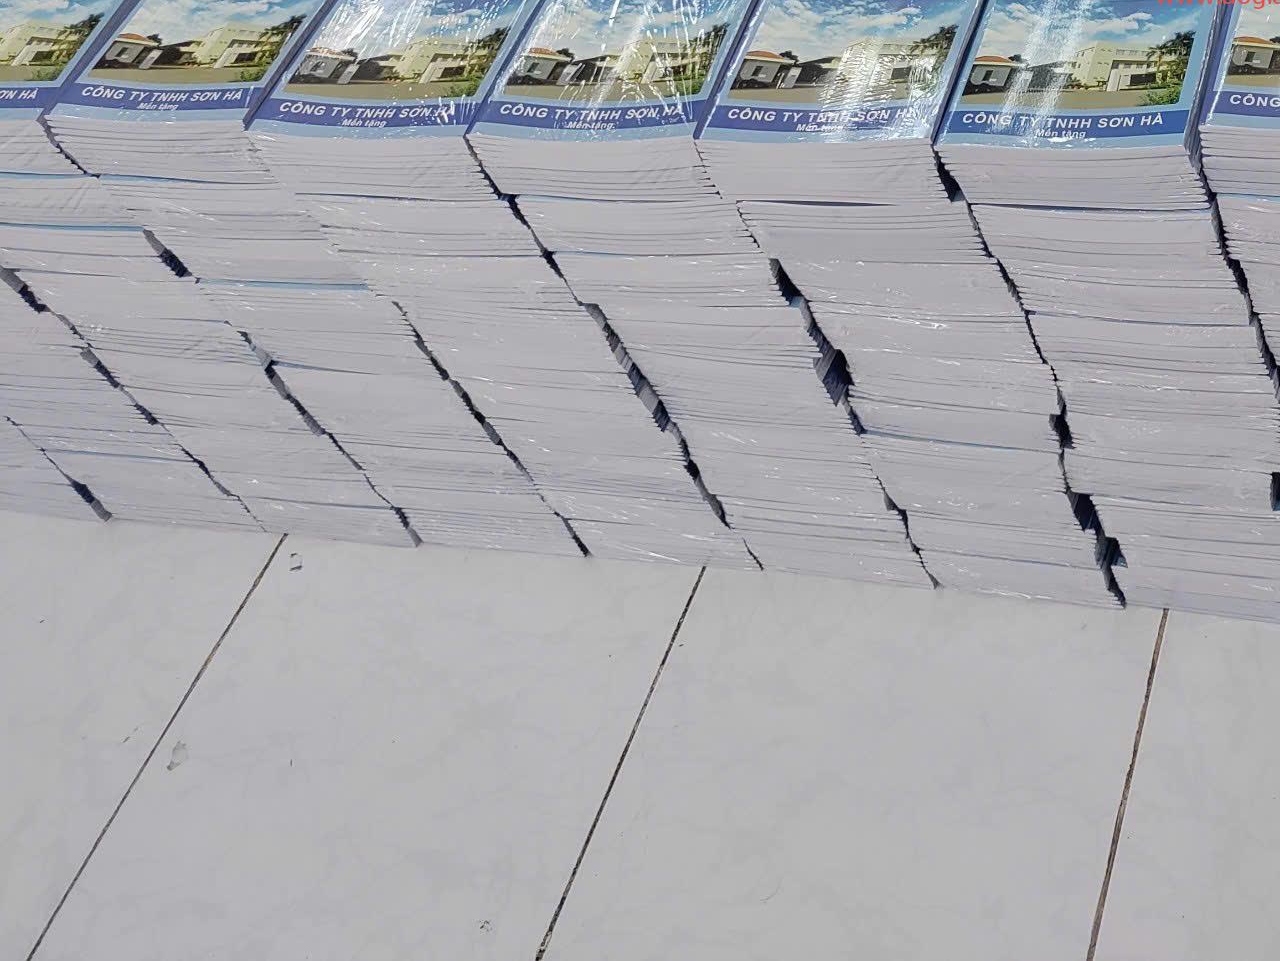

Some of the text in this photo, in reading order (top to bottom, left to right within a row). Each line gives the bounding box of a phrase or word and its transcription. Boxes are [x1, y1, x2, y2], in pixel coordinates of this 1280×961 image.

[0, 90, 16, 99] ƠN
[82, 85, 243, 103] CÔNG TY TNHH SƠN HÀ
[279, 101, 327, 116] CÔNG
[330, 106, 352, 117] TY
[350, 107, 395, 119] TNHH
[400, 106, 434, 119] SƠN
[500, 103, 684, 121] CÔNG TY TNHH SƠN HÀ
[962, 109, 1164, 129] CÔNG TY TNHH SƠN HÀ
